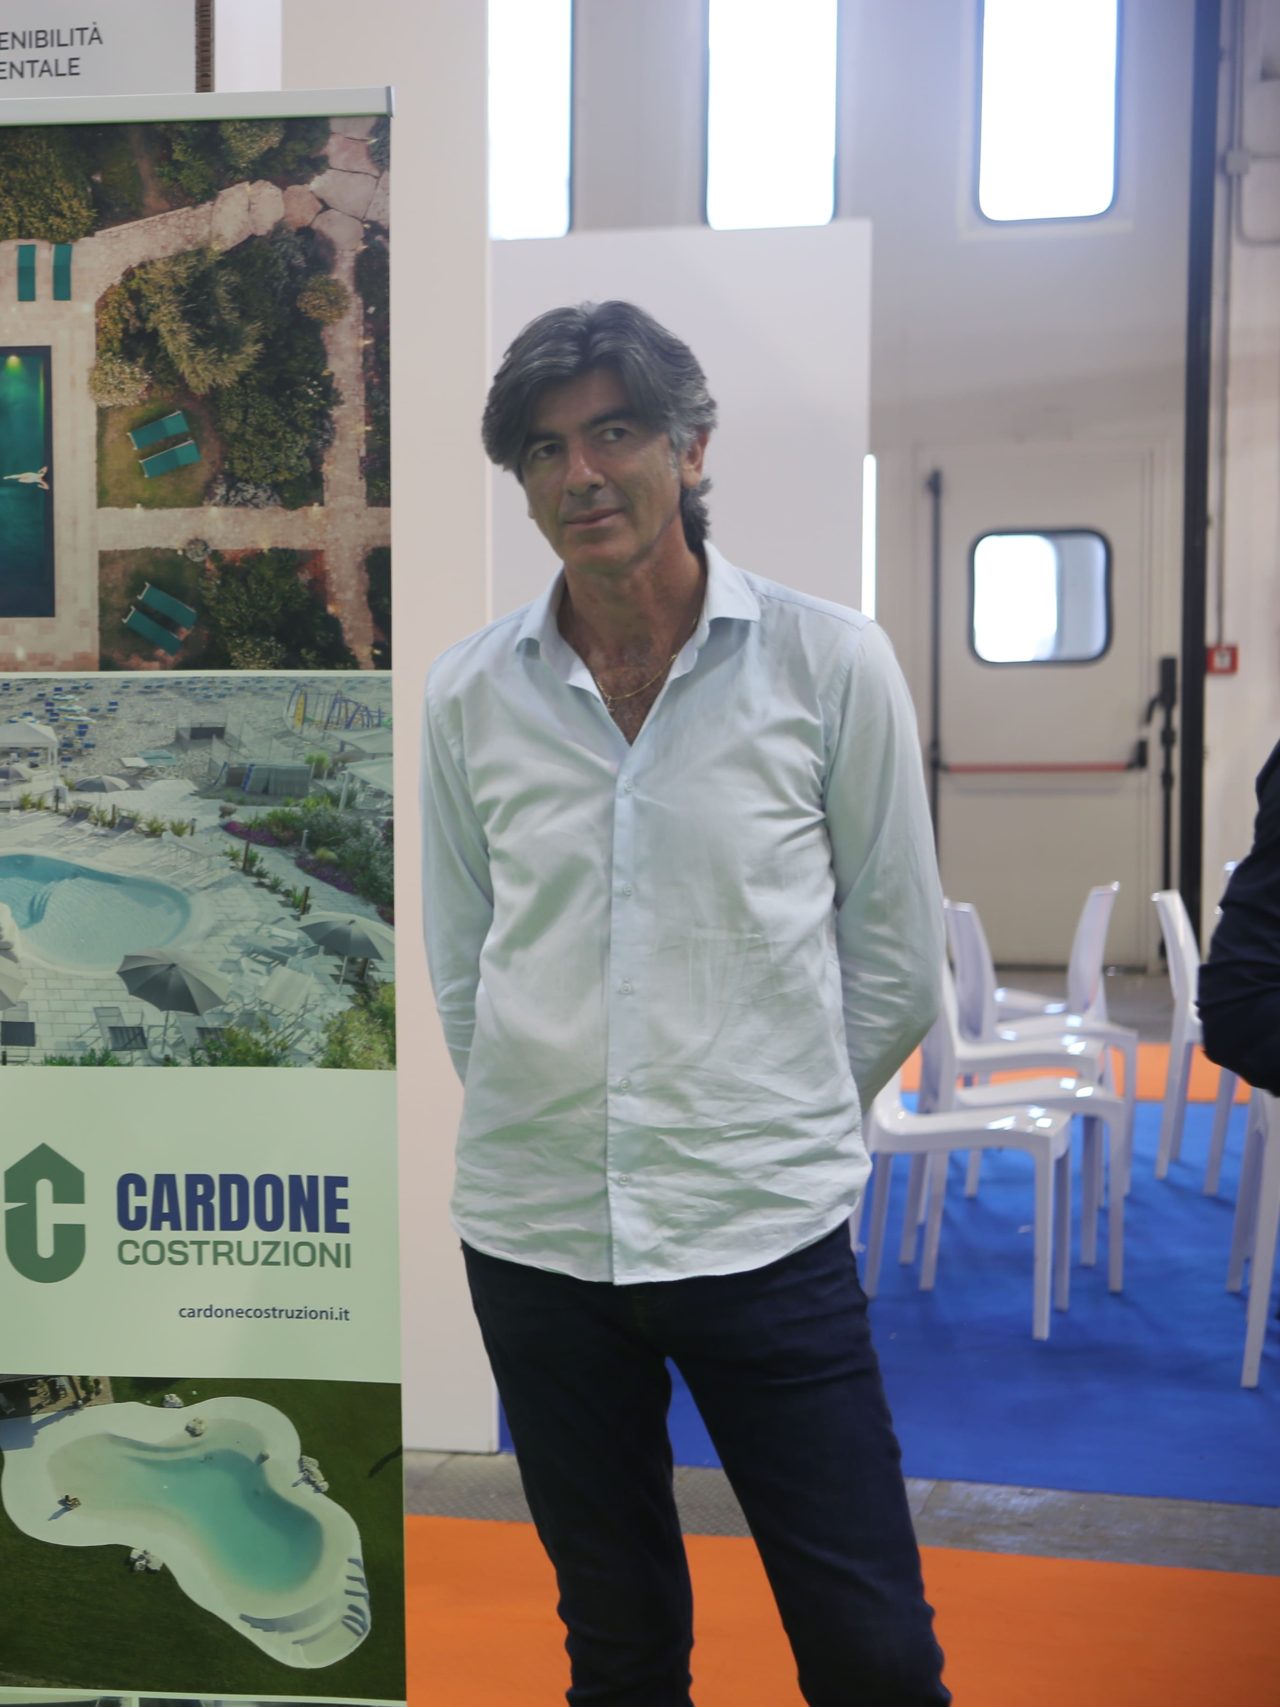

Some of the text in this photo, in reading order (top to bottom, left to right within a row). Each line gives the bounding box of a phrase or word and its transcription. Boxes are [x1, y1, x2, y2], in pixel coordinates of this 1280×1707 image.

[116, 1172, 351, 1234] CARDONE
[117, 1239, 351, 1269] COSTRUZIONI
[178, 1304, 351, 1322] cardonecostruzioni.it
